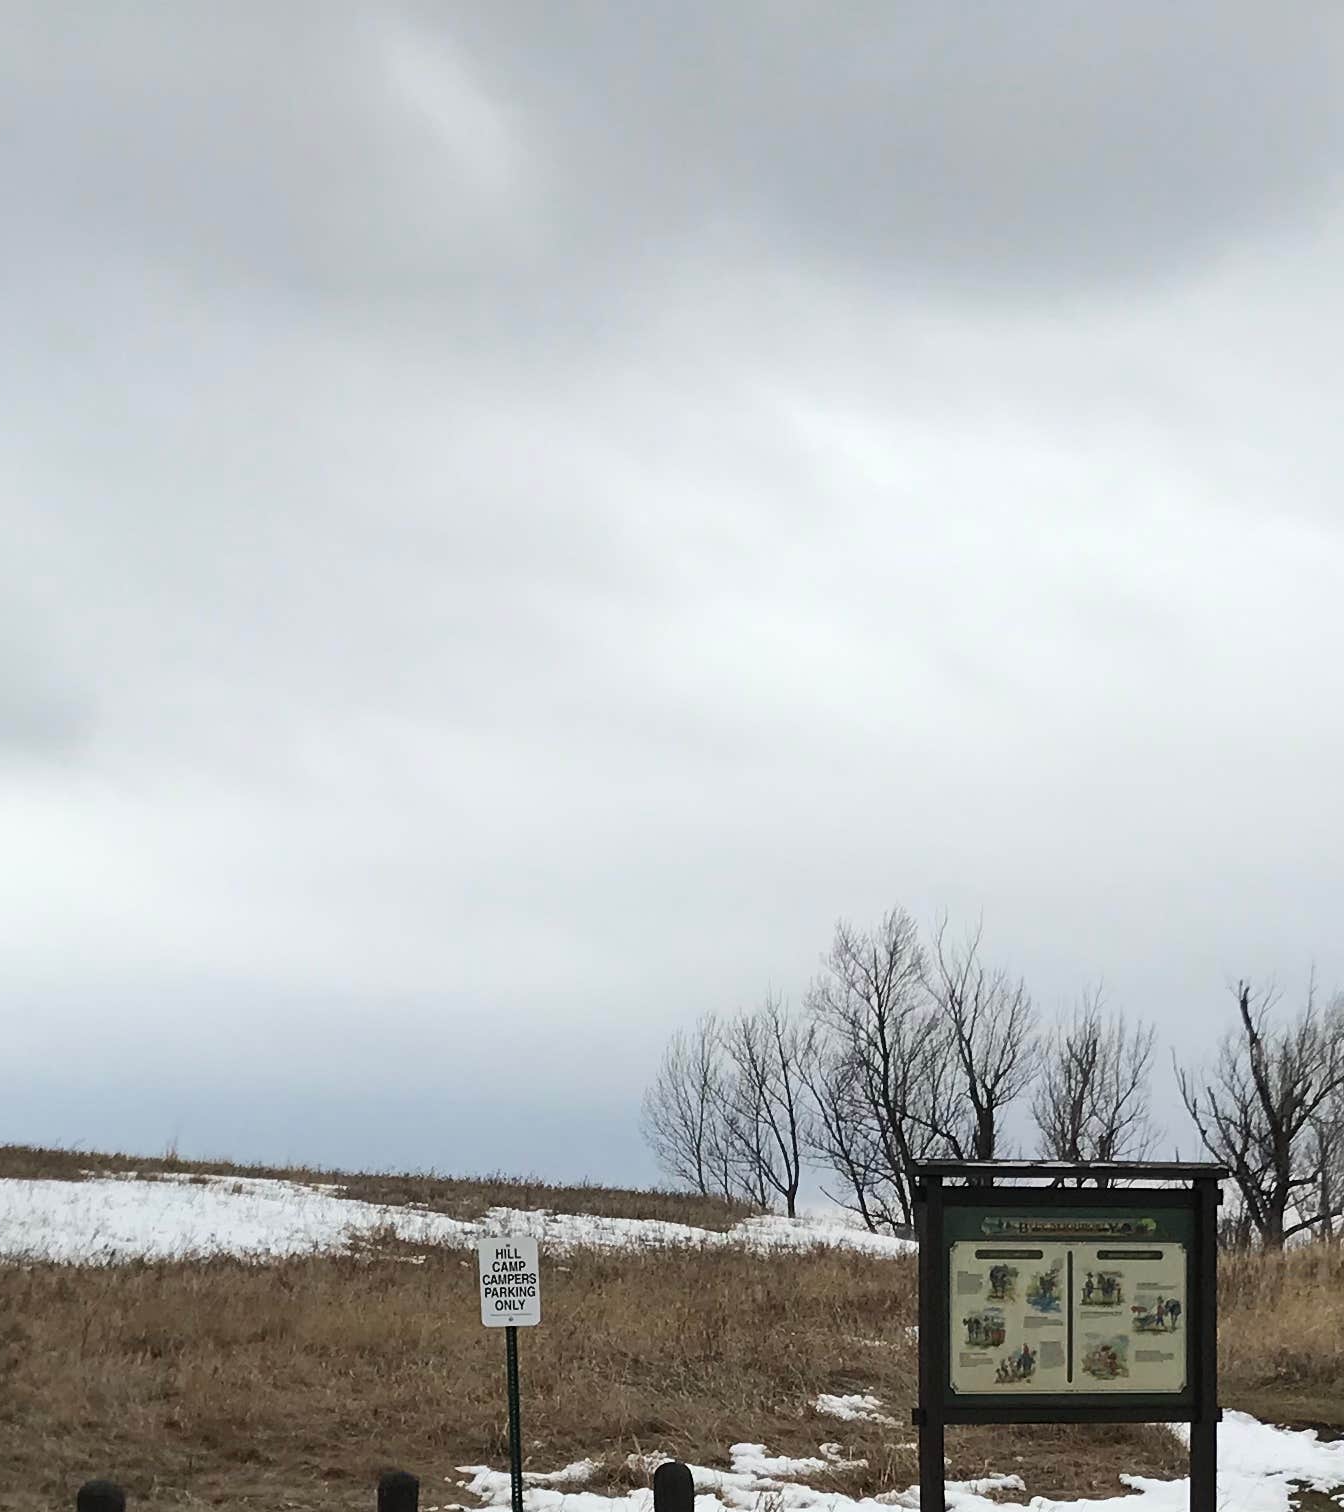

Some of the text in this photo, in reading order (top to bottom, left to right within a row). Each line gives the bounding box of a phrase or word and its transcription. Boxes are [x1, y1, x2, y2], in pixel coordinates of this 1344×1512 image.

[495, 1248, 522, 1260] HILL
[492, 1260, 527, 1273] CAMP
[482, 1272, 537, 1286] CAMPERS
[484, 1286, 536, 1298] PARKING
[495, 1299, 526, 1311] ONLY
